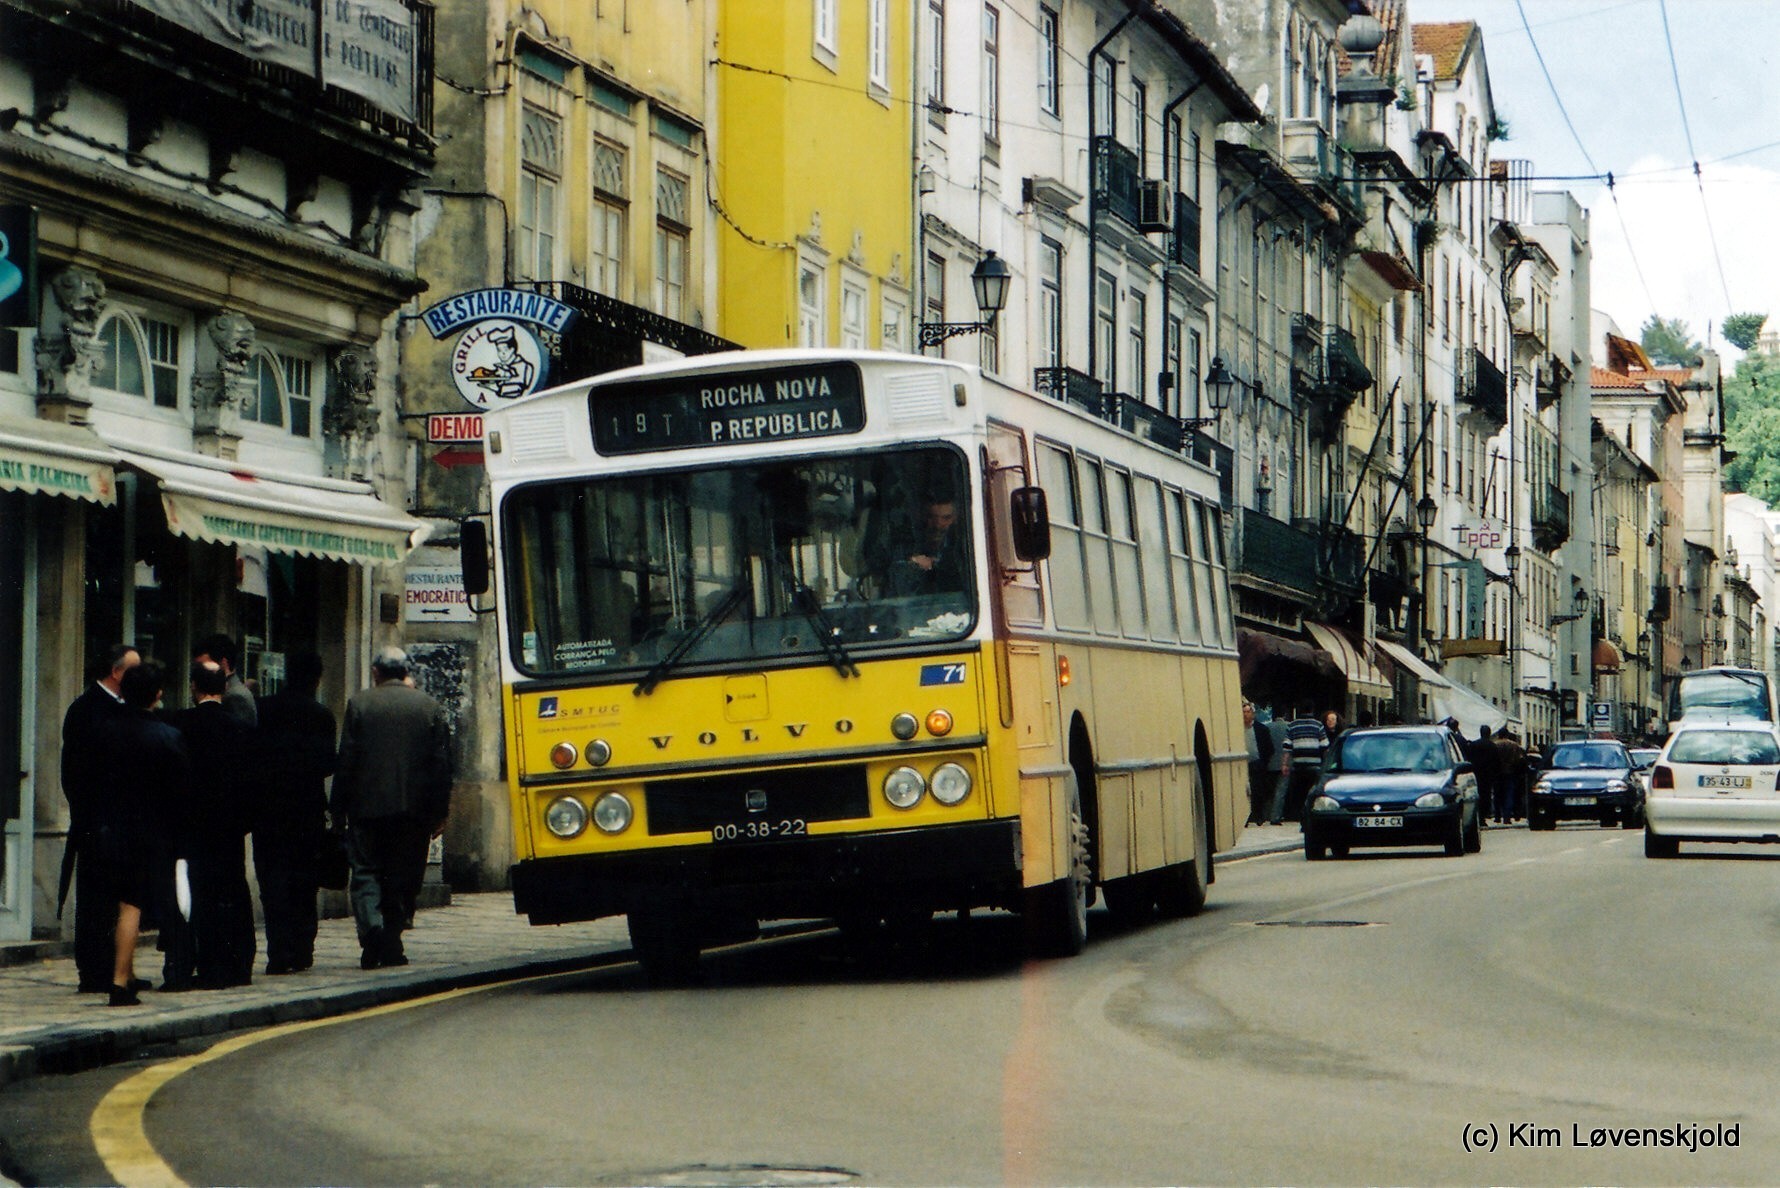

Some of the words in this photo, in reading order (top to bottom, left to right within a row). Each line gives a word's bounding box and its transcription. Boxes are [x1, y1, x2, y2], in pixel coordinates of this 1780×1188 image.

[428, 291, 567, 332] RESTAURANTE
[455, 327, 487, 374] GRILL
[701, 383, 766, 409] ROCHA
[775, 376, 831, 400] NOVA
[1468, 532, 1500, 549] PCP
[943, 664, 965, 682] 71
[648, 719, 854, 750] VOLVO
[713, 819, 806, 841] 00-38-22
